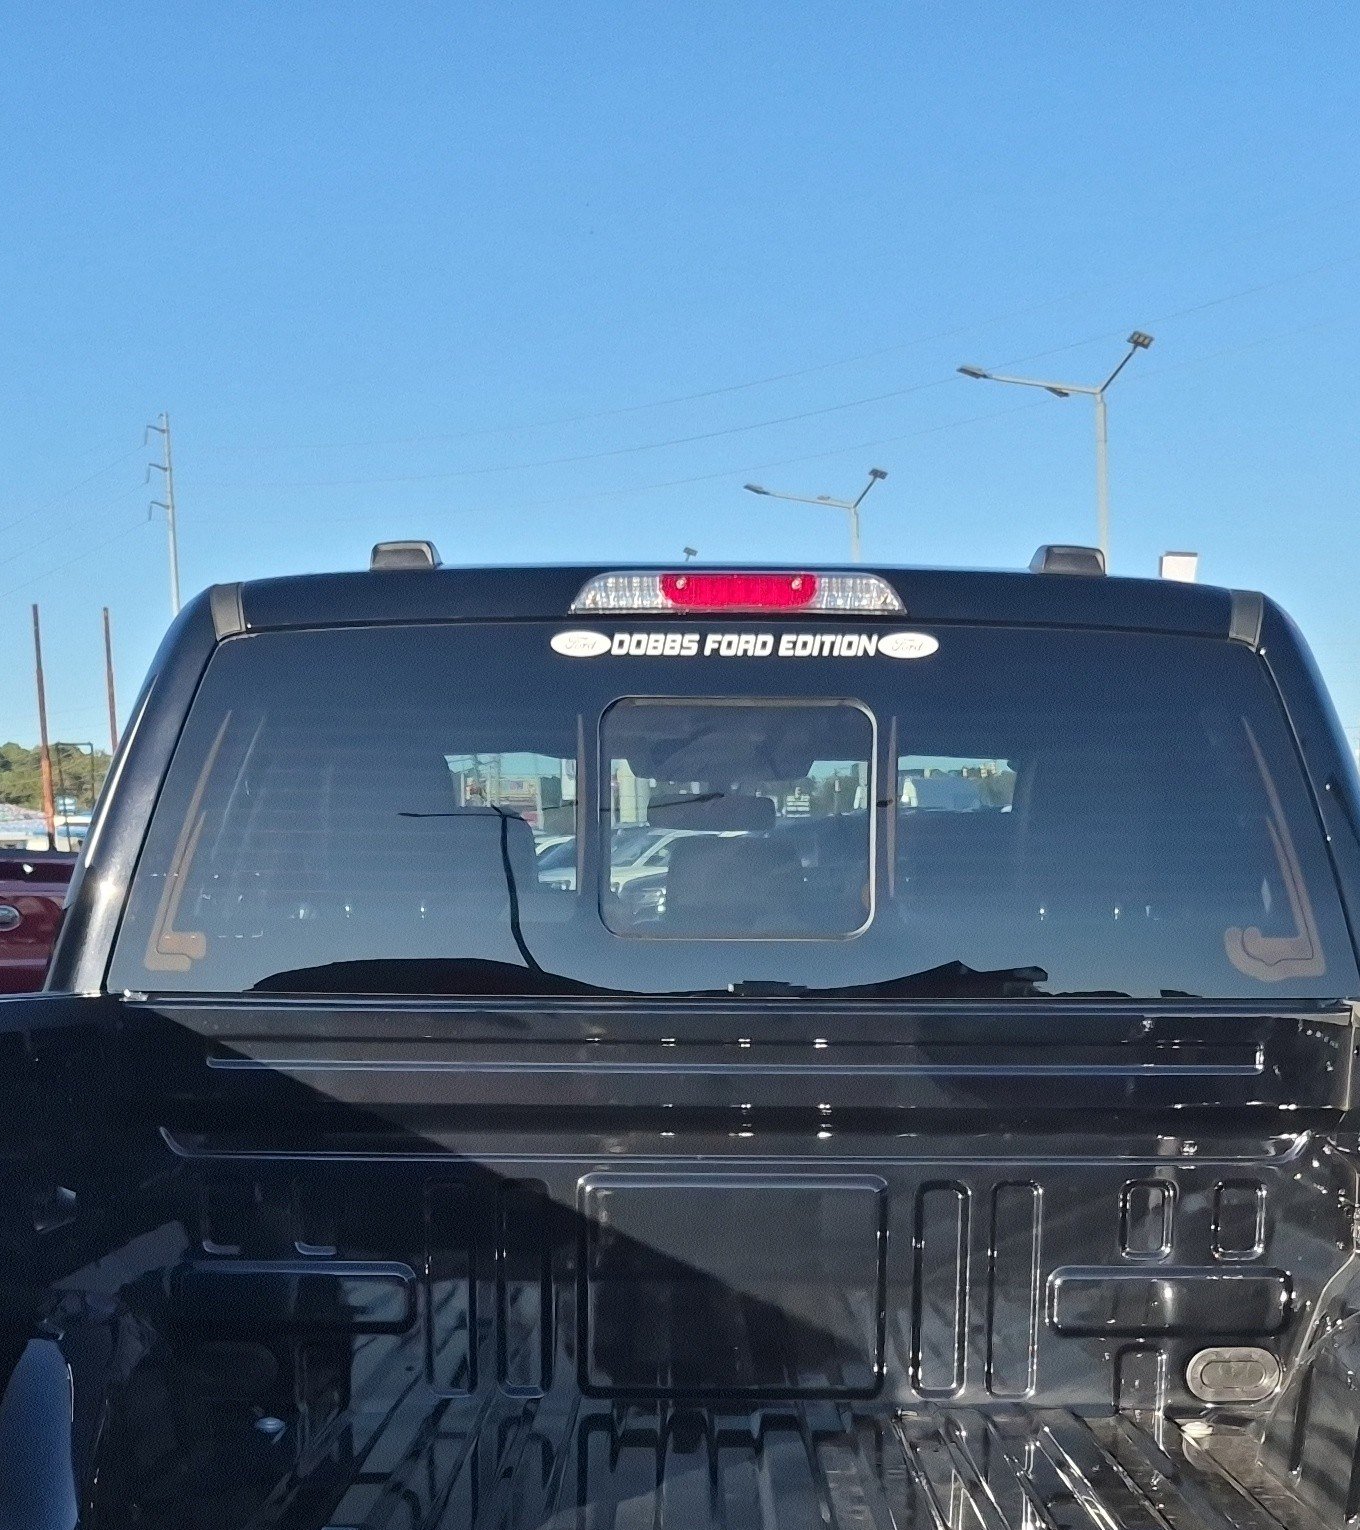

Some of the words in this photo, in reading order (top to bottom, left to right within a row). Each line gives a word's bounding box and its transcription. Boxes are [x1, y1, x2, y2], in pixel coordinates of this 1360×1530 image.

[610, 632, 700, 656] DOBBS
[703, 633, 775, 657] FORD
[778, 633, 879, 657] EDITION
